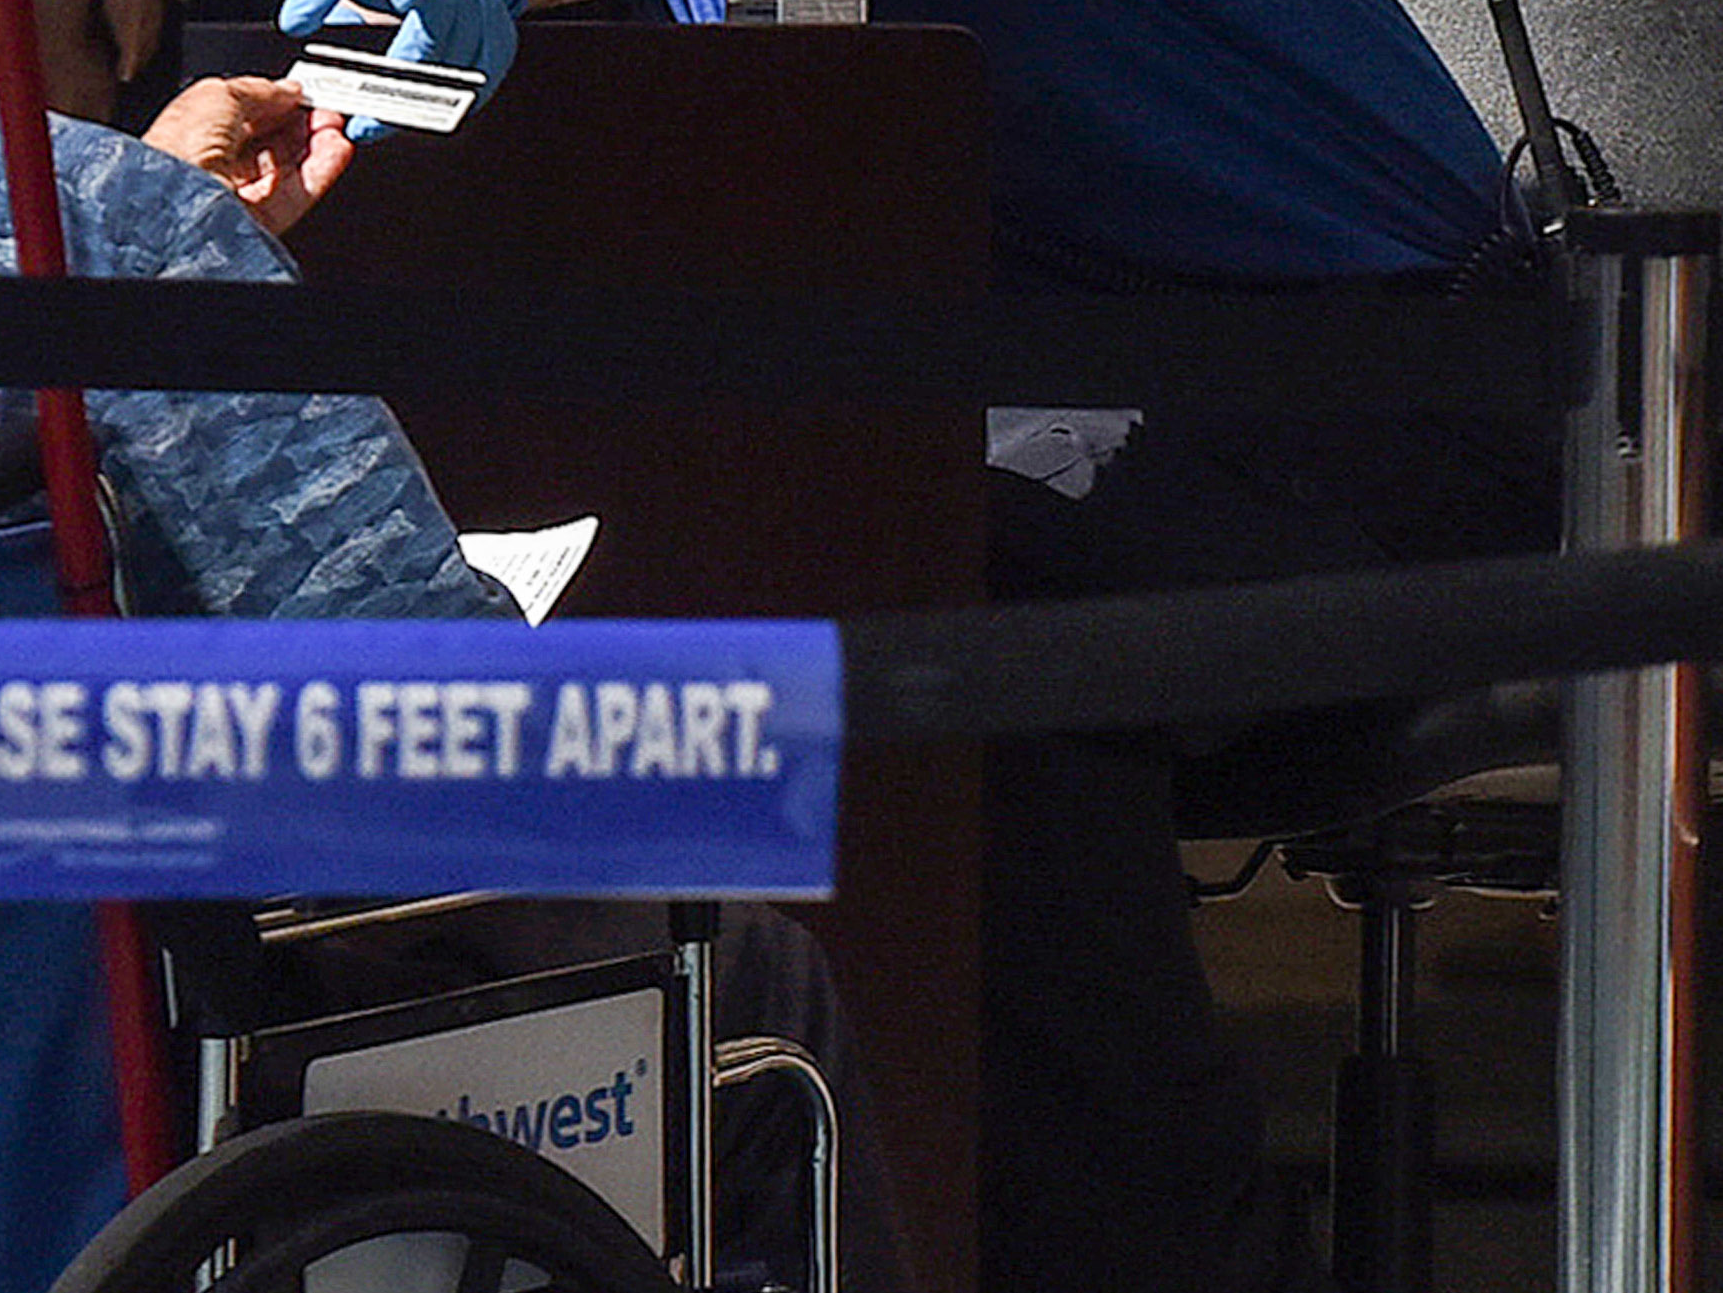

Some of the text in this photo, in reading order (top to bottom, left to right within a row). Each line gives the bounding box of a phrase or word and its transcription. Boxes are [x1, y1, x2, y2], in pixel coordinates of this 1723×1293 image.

[102, 680, 279, 780] STAY
[293, 680, 342, 780] 6
[356, 680, 533, 780] FEET
[544, 680, 782, 780] APART.
